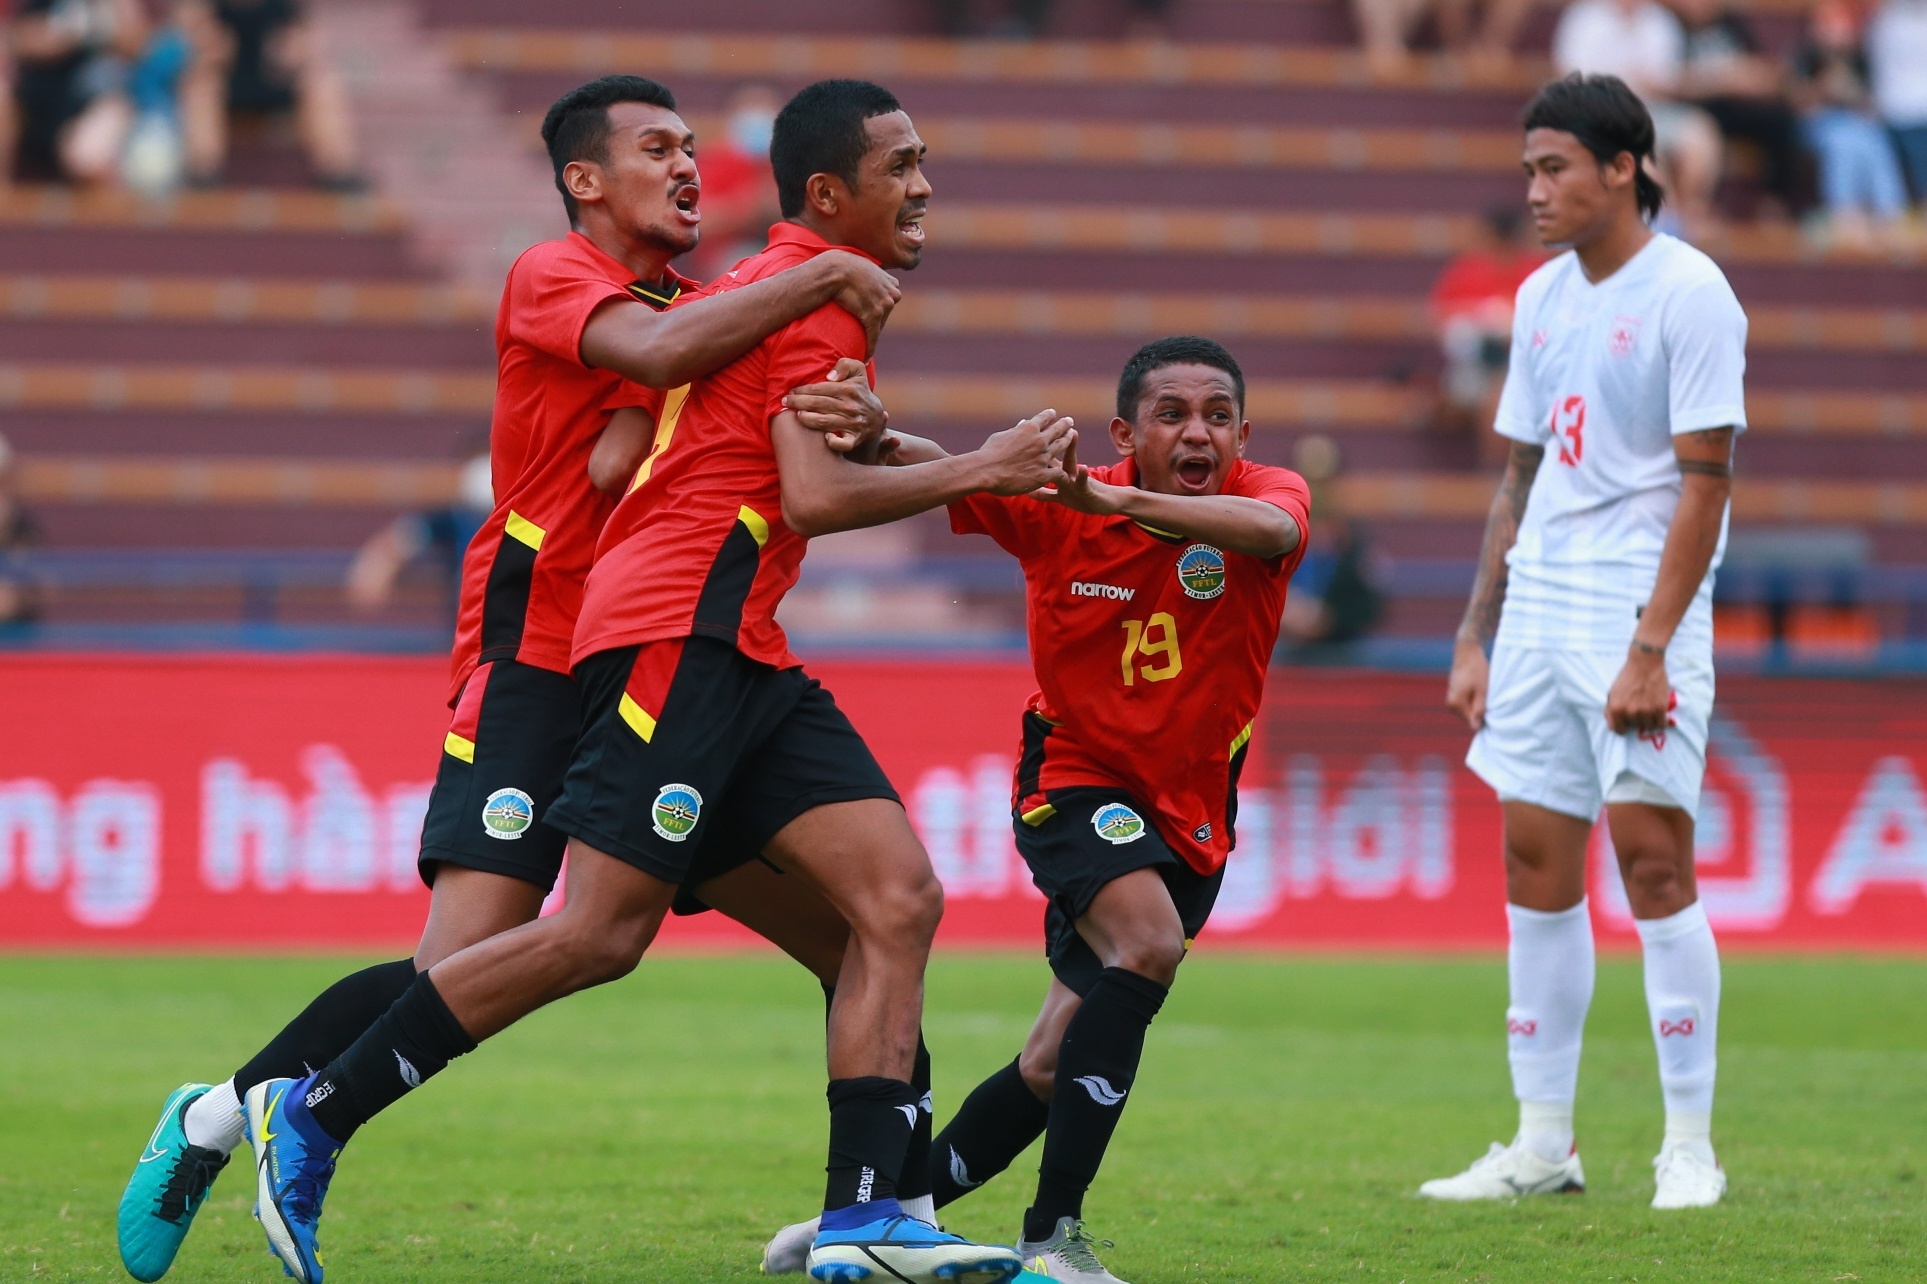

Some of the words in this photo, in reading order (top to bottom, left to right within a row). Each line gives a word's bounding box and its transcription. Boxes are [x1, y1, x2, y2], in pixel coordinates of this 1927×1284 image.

[1192, 578, 1217, 588] FFTL
[1071, 581, 1135, 601] narrow
[1121, 611, 1183, 687] 19
[494, 819, 517, 829] FFTL
[664, 817, 684, 831] FFTL
